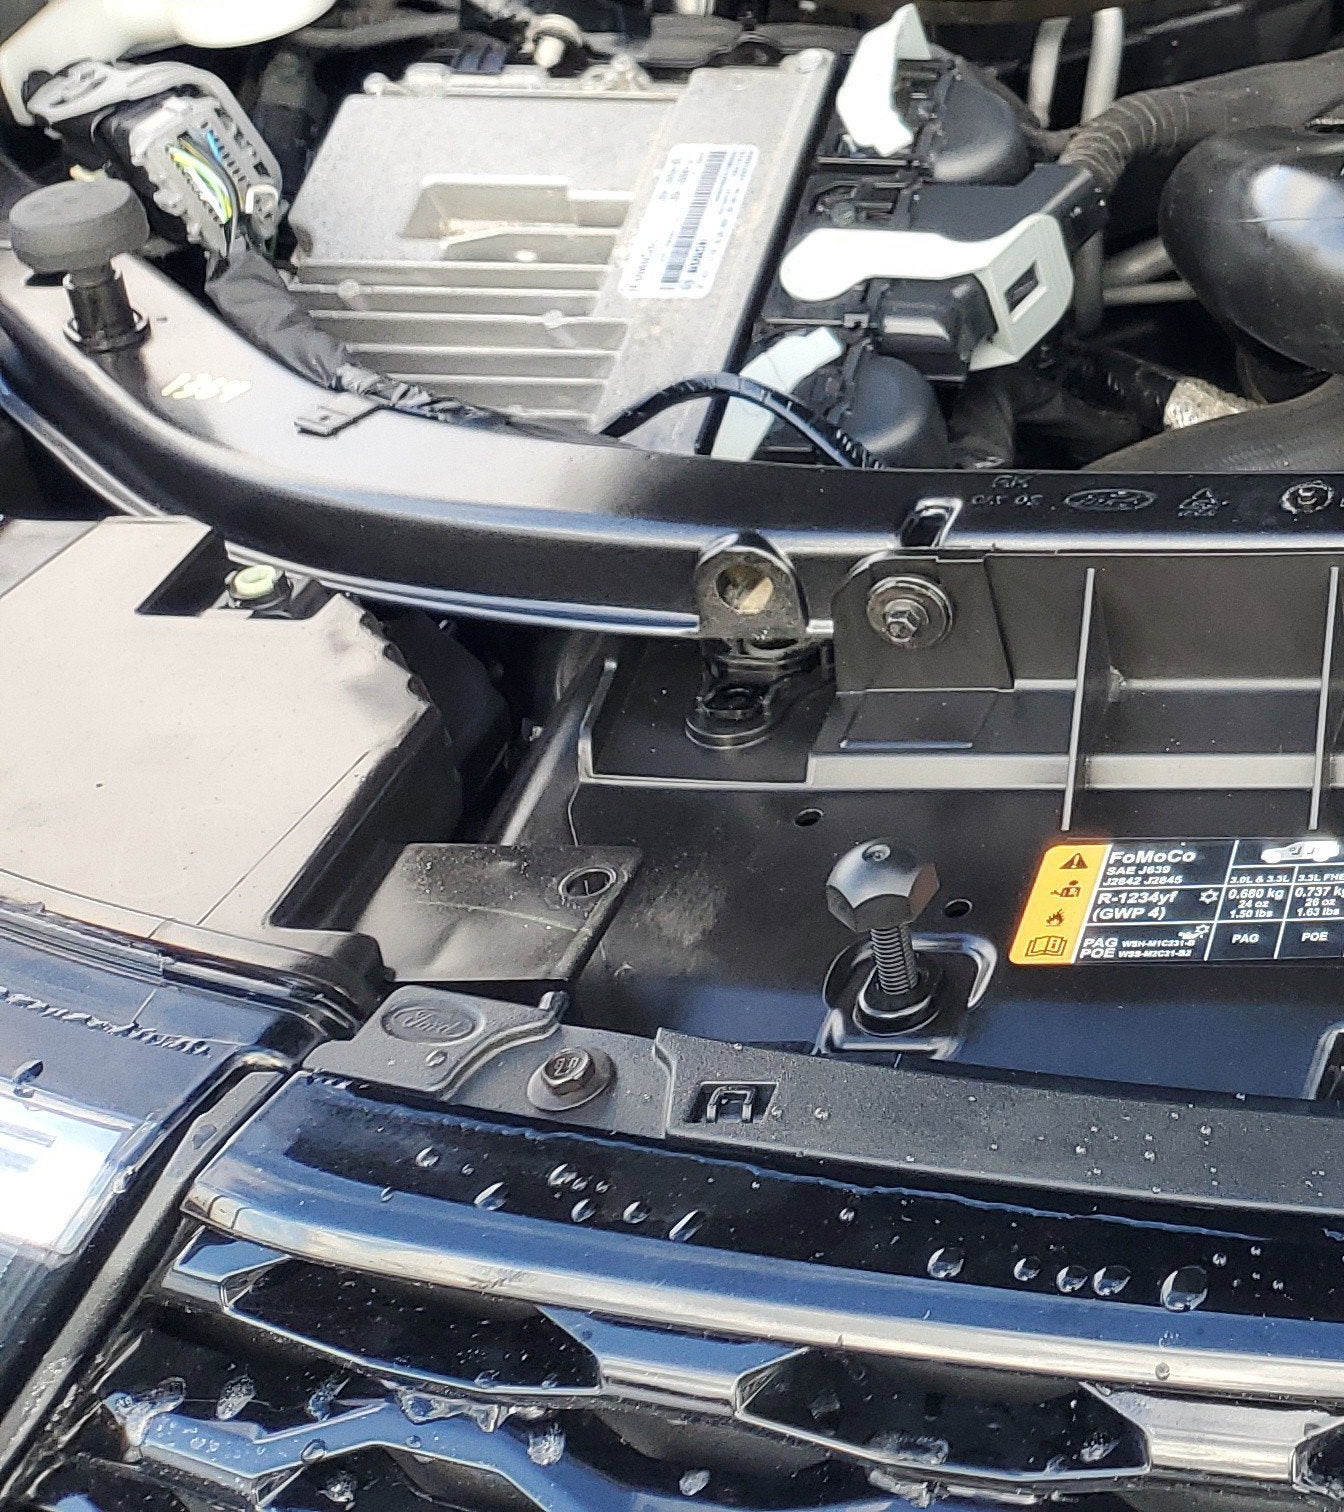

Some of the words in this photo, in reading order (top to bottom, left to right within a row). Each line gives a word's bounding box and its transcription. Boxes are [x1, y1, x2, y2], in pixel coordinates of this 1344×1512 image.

[1109, 850, 1197, 864] FoMoCo
[1106, 866, 1135, 876] SAE
[1097, 891, 1179, 905] R-1234yf
[1228, 888, 1264, 899] 0.680
[1267, 888, 1285, 900] kg
[1295, 887, 1331, 898] 0.737
[1238, 900, 1253, 908] 24
[1255, 900, 1269, 908] oz
[1322, 898, 1336, 906] oz
[1092, 908, 1145, 922] (GWP
[1147, 907, 1166, 920] 4)
[1229, 909, 1253, 918] 1.50
[1255, 909, 1273, 918] lbs
[1296, 907, 1320, 916] 1.63
[1322, 907, 1340, 916] lbs
[1231, 933, 1260, 944] PAG
[1302, 931, 1329, 942] POE
[1083, 938, 1118, 948] PAG
[1080, 948, 1116, 959] POE
